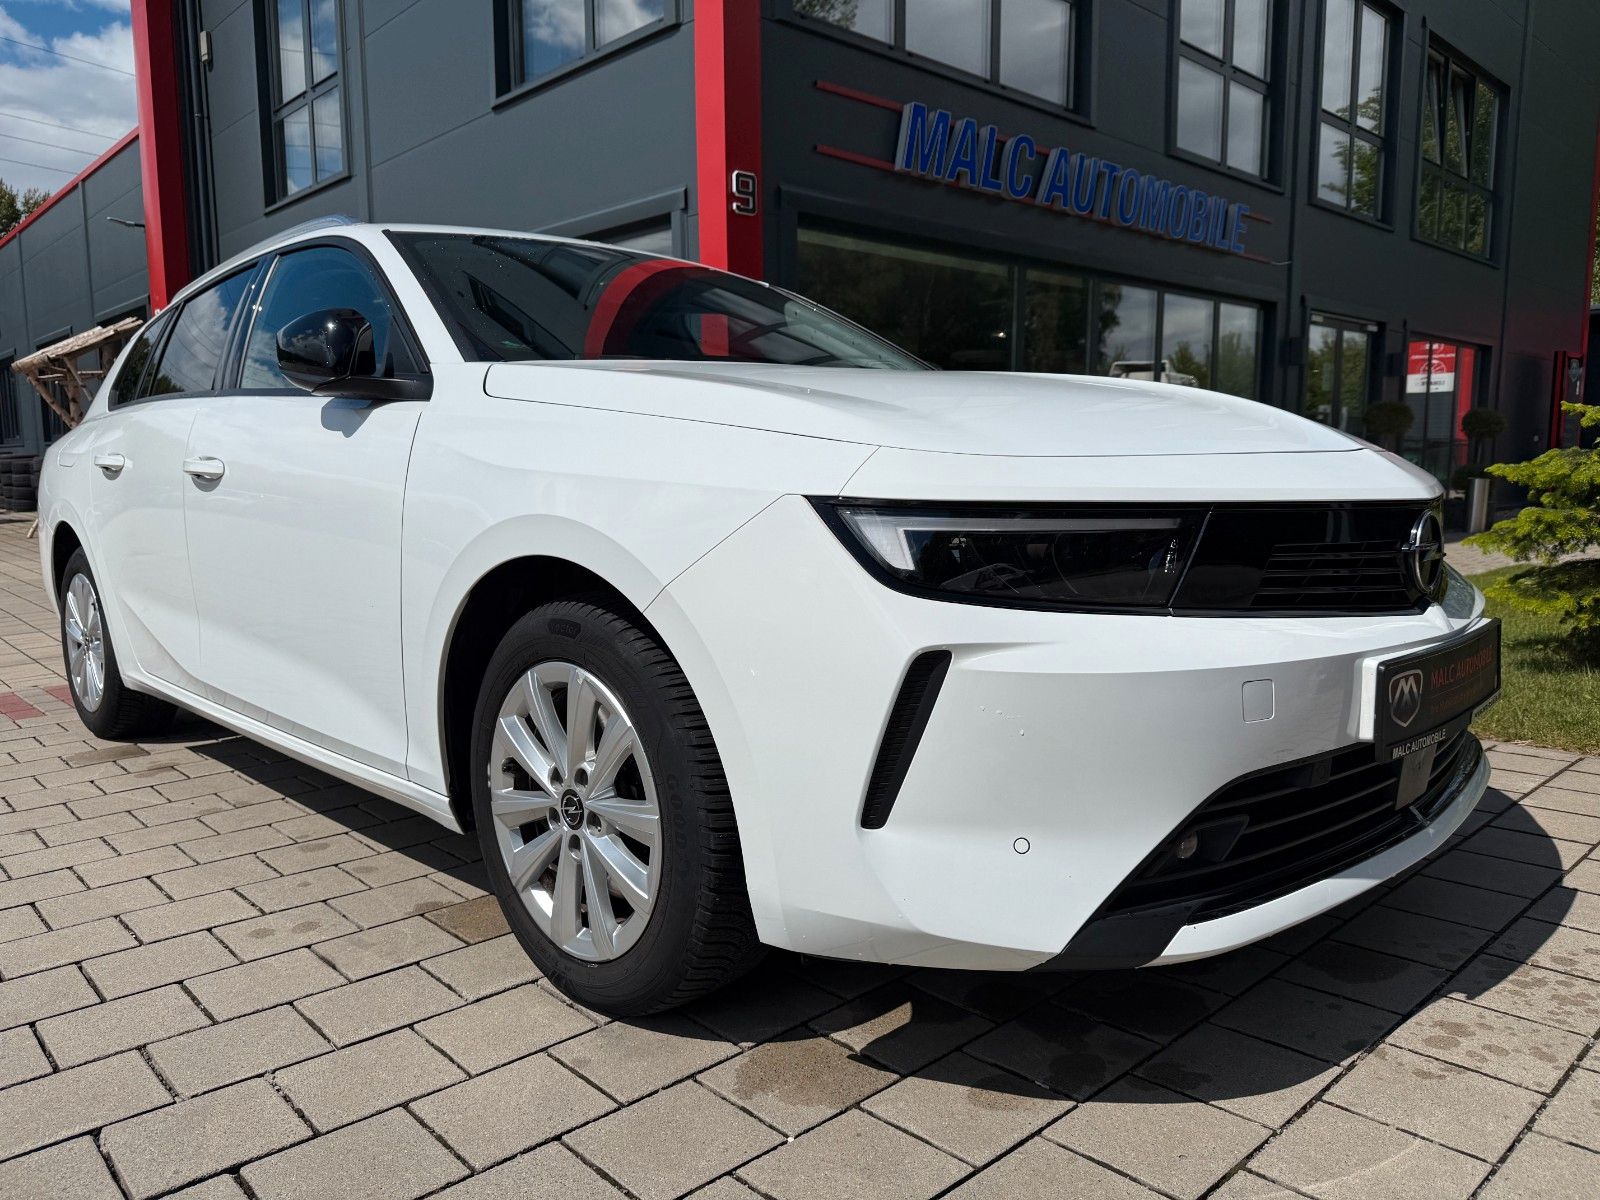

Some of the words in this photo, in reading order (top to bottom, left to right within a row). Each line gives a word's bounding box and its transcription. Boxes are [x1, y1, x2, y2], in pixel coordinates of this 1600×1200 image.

[732, 169, 757, 216] 9
[895, 101, 1035, 198] MALC
[1036, 147, 1250, 254] AUTOMOBILE
[1431, 661, 1456, 689] MALC
[1392, 743, 1411, 760] MALC
[1411, 728, 1446, 753] AUTOMOBILE
